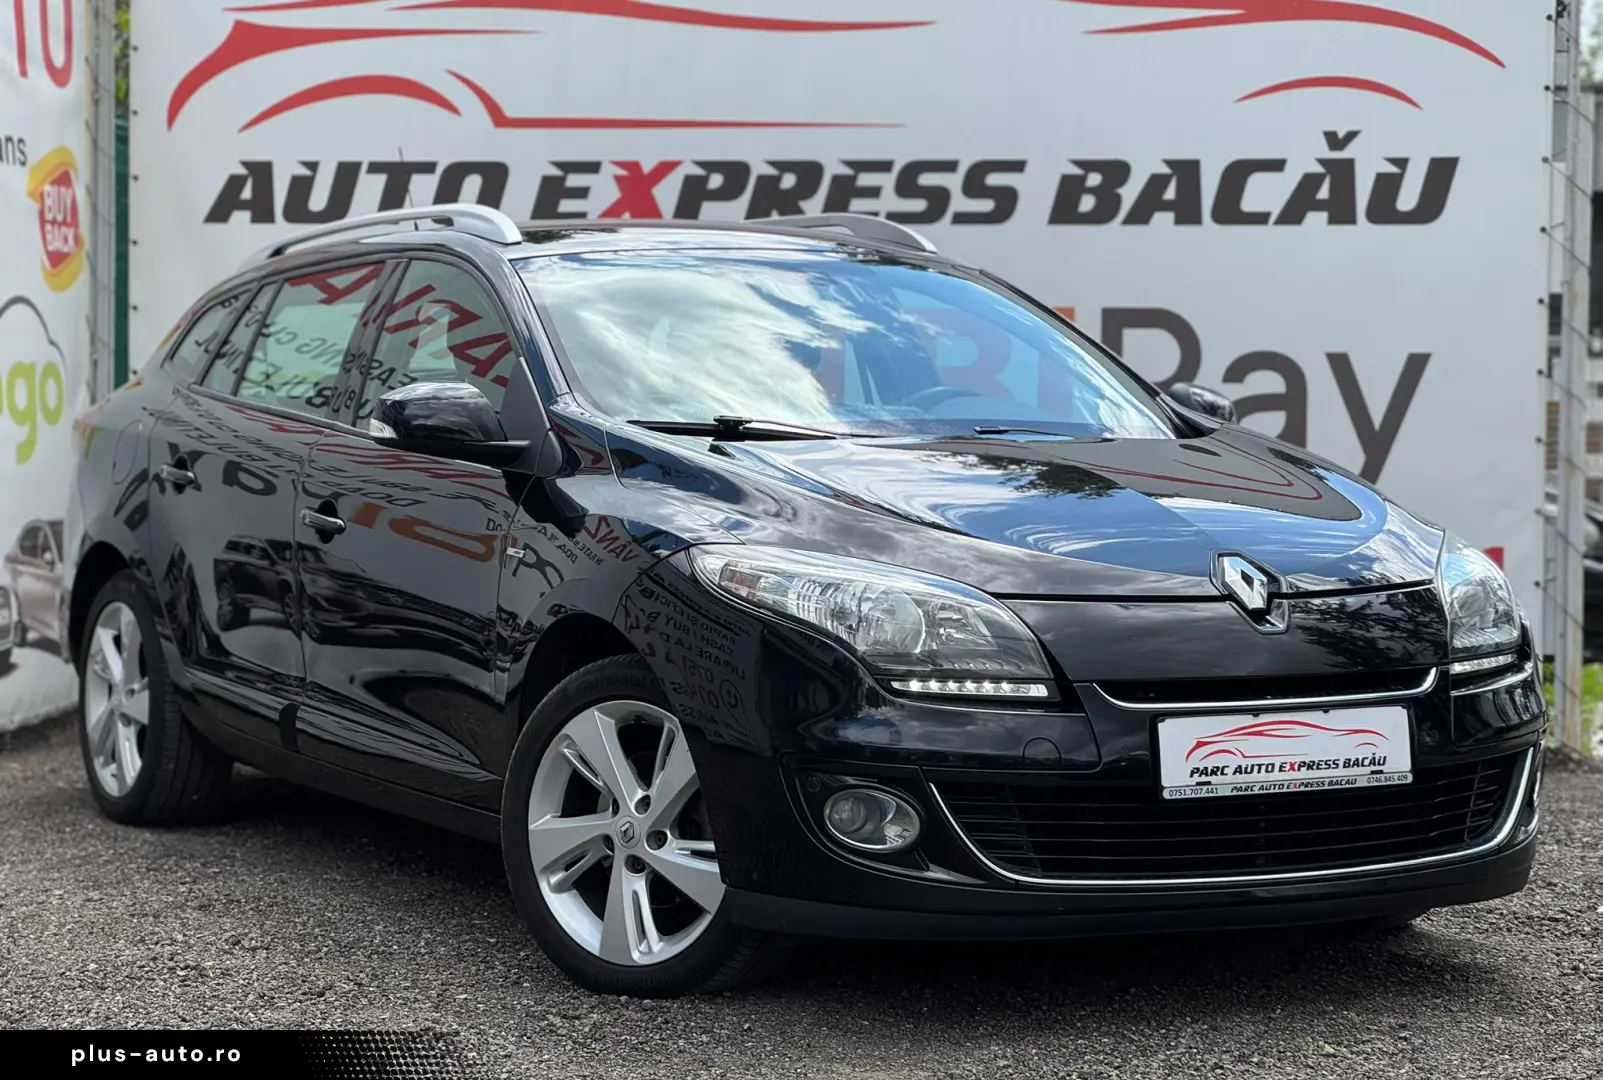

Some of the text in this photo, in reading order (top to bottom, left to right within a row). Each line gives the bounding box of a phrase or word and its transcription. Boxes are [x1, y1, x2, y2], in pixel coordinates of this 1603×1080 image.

[203, 130, 1460, 226] AUTO EXPRESS BACĂU
[43, 185, 73, 222] BUY
[44, 223, 76, 252] BACK
[0, 360, 64, 465] go
[1189, 752, 1387, 778] PARC AUTO EXPRESS BACĂU
[1168, 774, 1408, 798] 0751.707.441 PARC AUTO EXPRESS BACAU 0746.845.409
